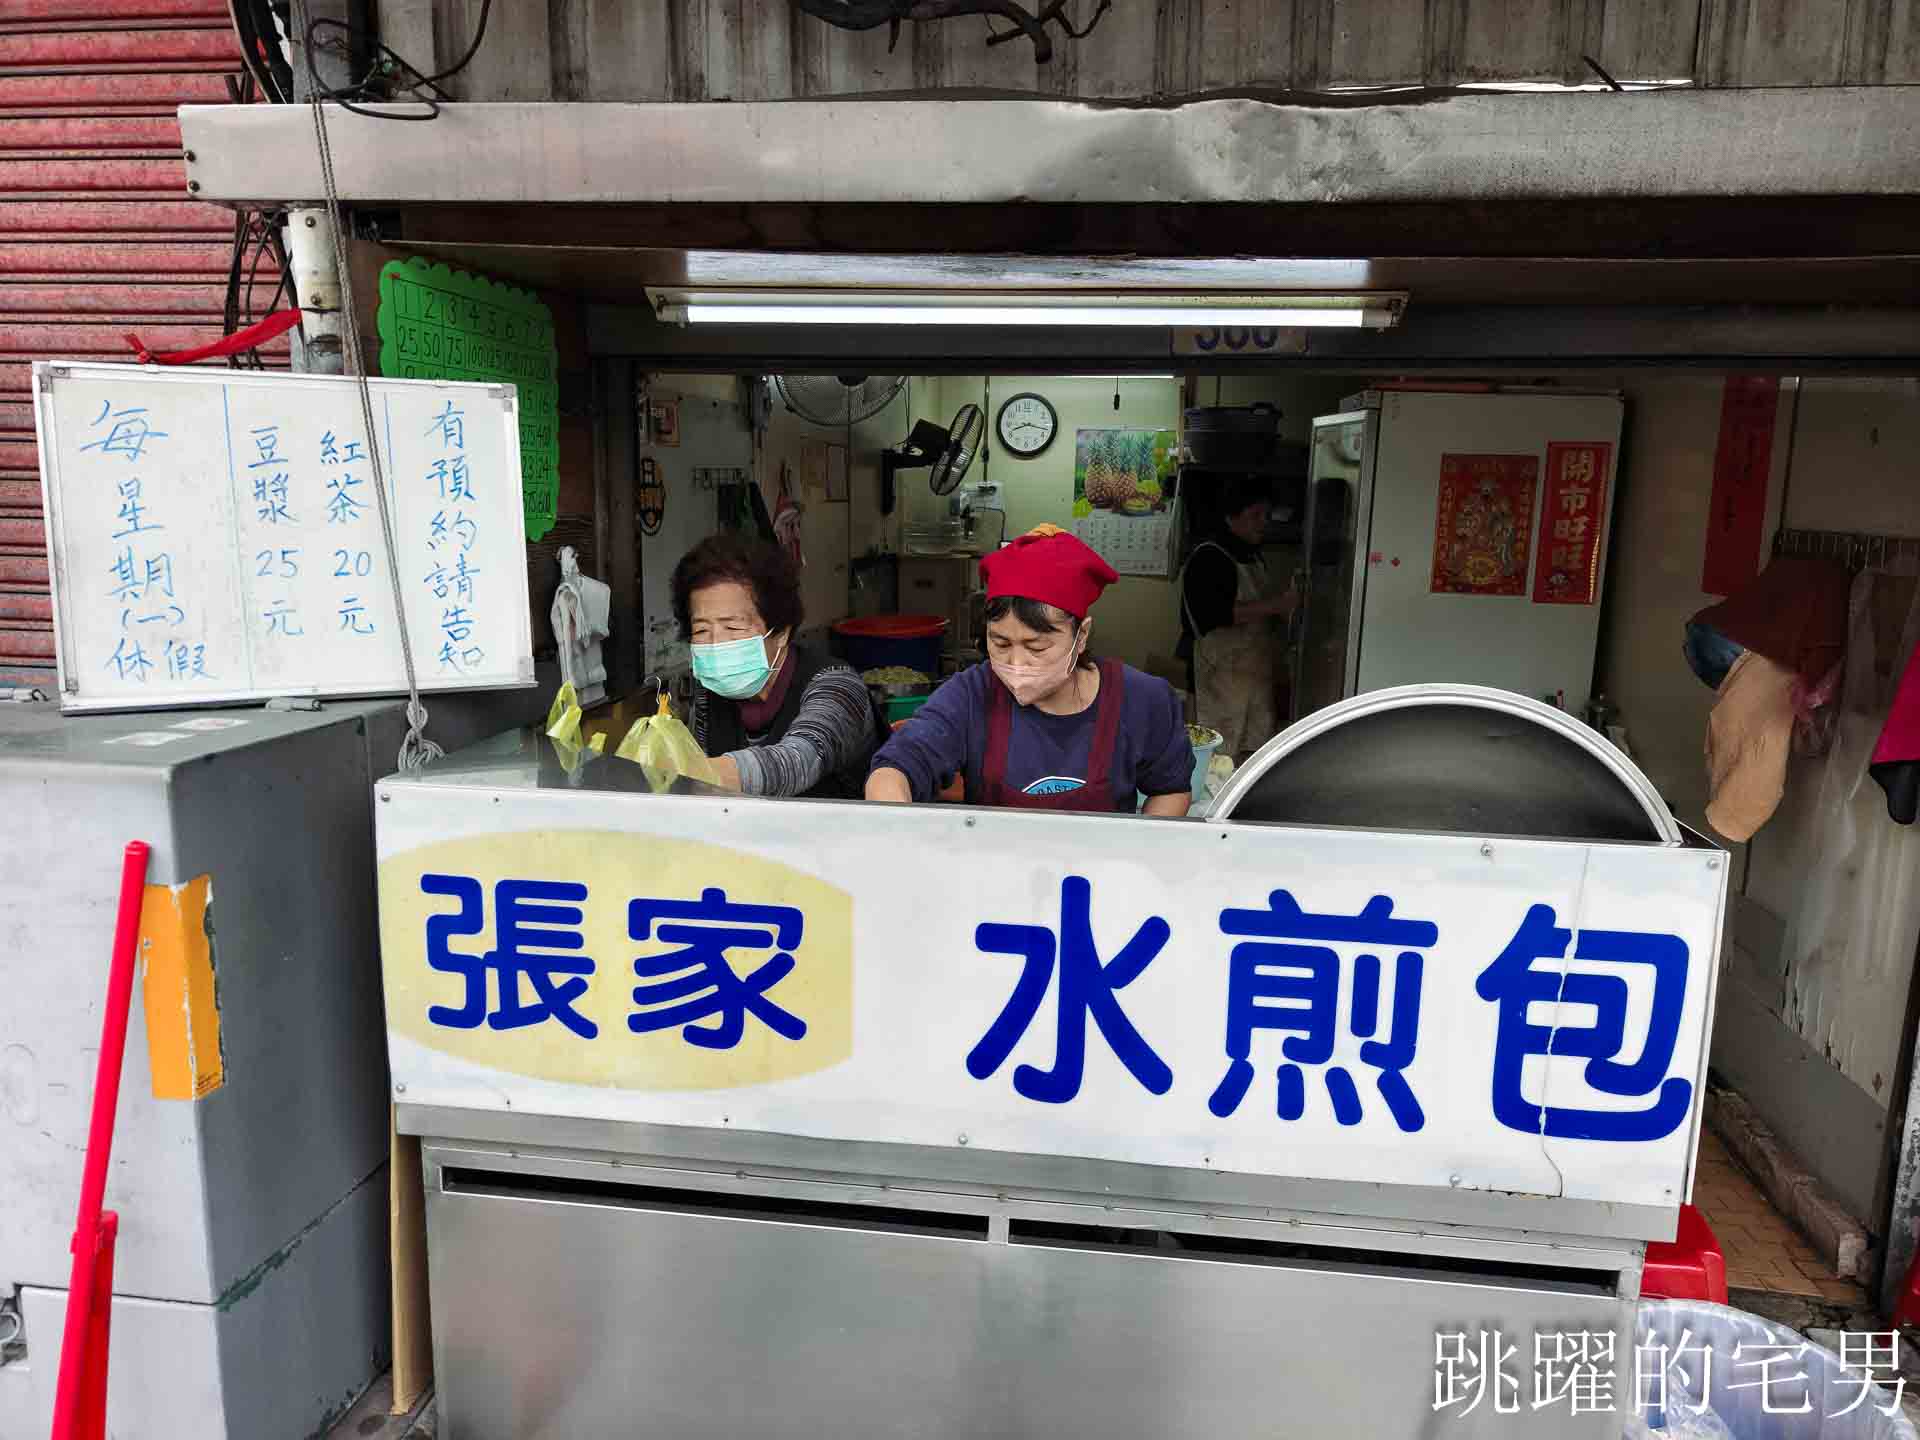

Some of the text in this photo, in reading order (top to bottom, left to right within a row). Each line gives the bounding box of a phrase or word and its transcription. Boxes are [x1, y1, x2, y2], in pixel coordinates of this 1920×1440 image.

[398, 325, 418, 356] 25
[423, 332, 441, 358] 50
[447, 336, 463, 365] 75
[424, 291, 435, 319] 2
[447, 298, 457, 325] 3
[469, 303, 480, 330] 4
[423, 399, 485, 675] 有預約請告知
[1551, 449, 1595, 571] 開市旺旺
[420, 873, 1692, 1142] 張家 水煎包
